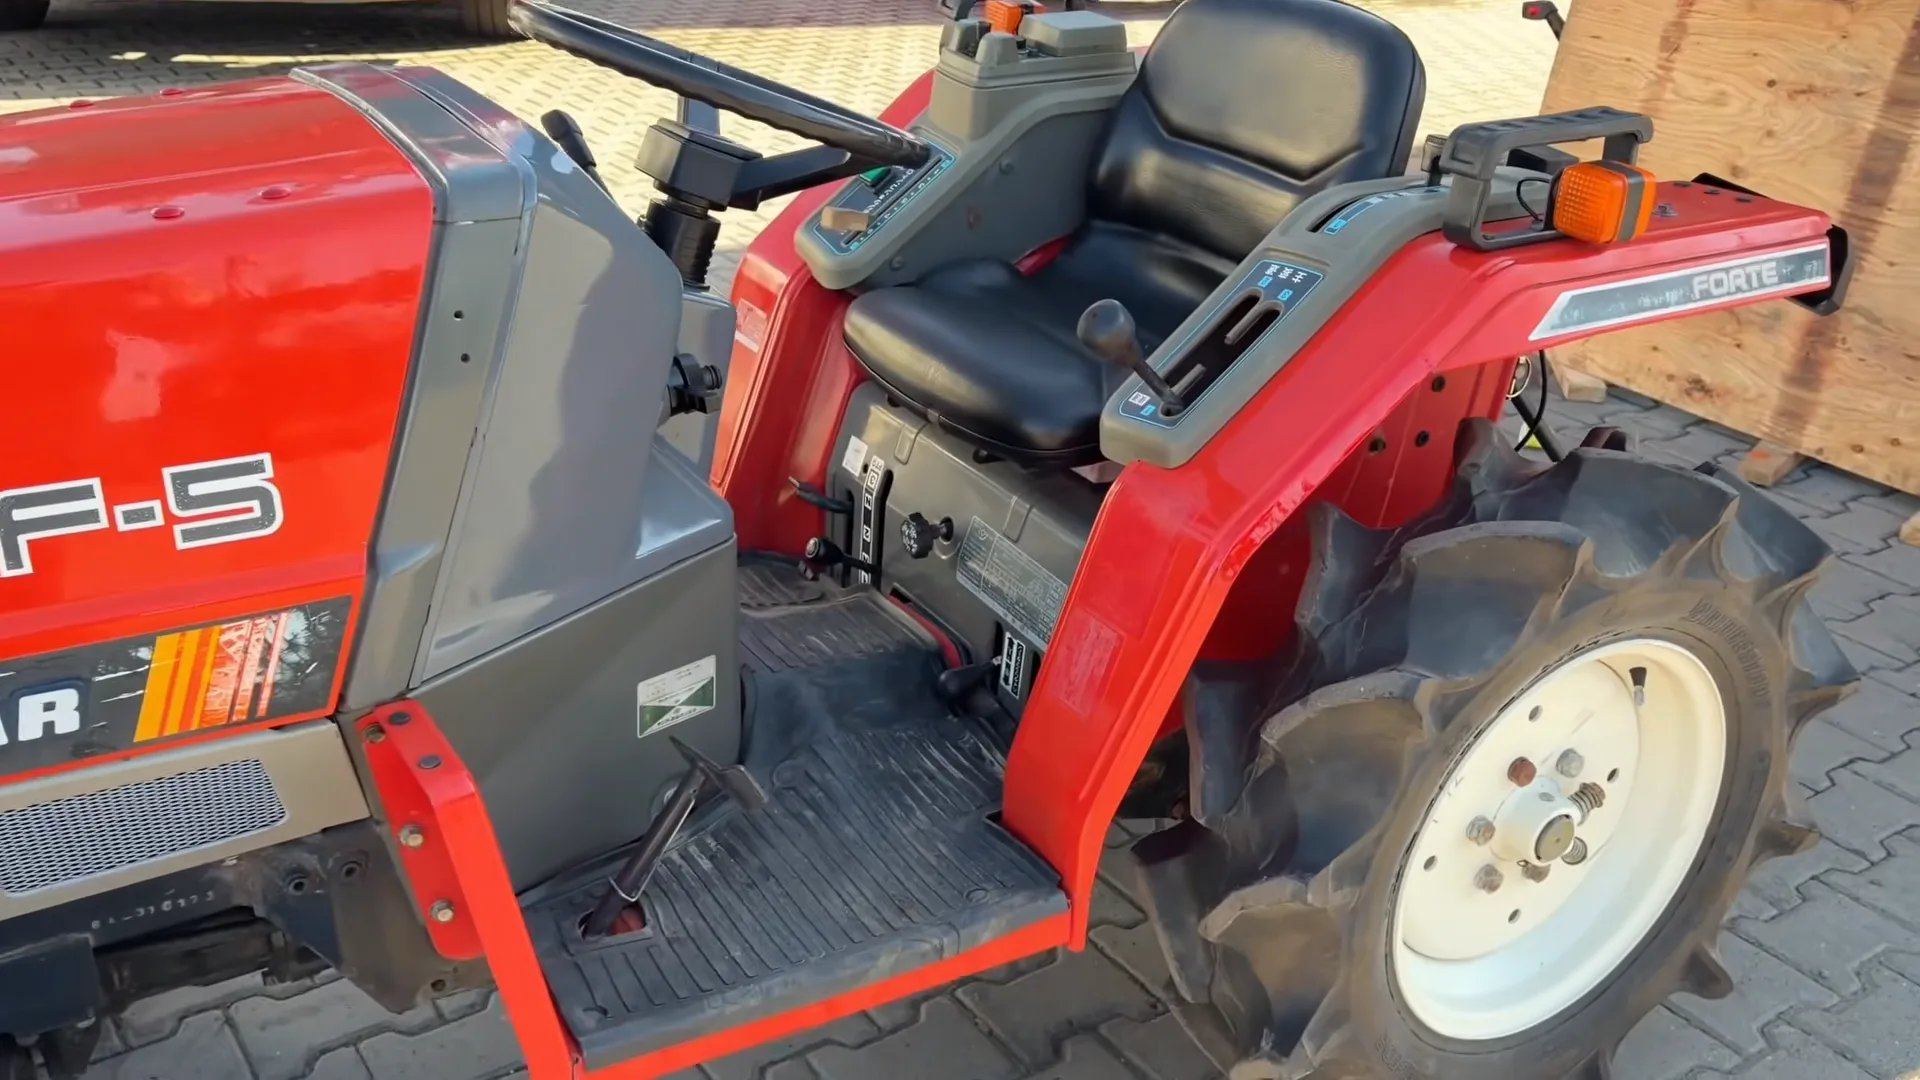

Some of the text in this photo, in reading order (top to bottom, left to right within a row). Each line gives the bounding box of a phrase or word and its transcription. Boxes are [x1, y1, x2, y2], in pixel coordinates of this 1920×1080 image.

[1690, 260, 1782, 302] FORTE
[0, 451, 284, 578] F-5
[0, 687, 81, 746] R
